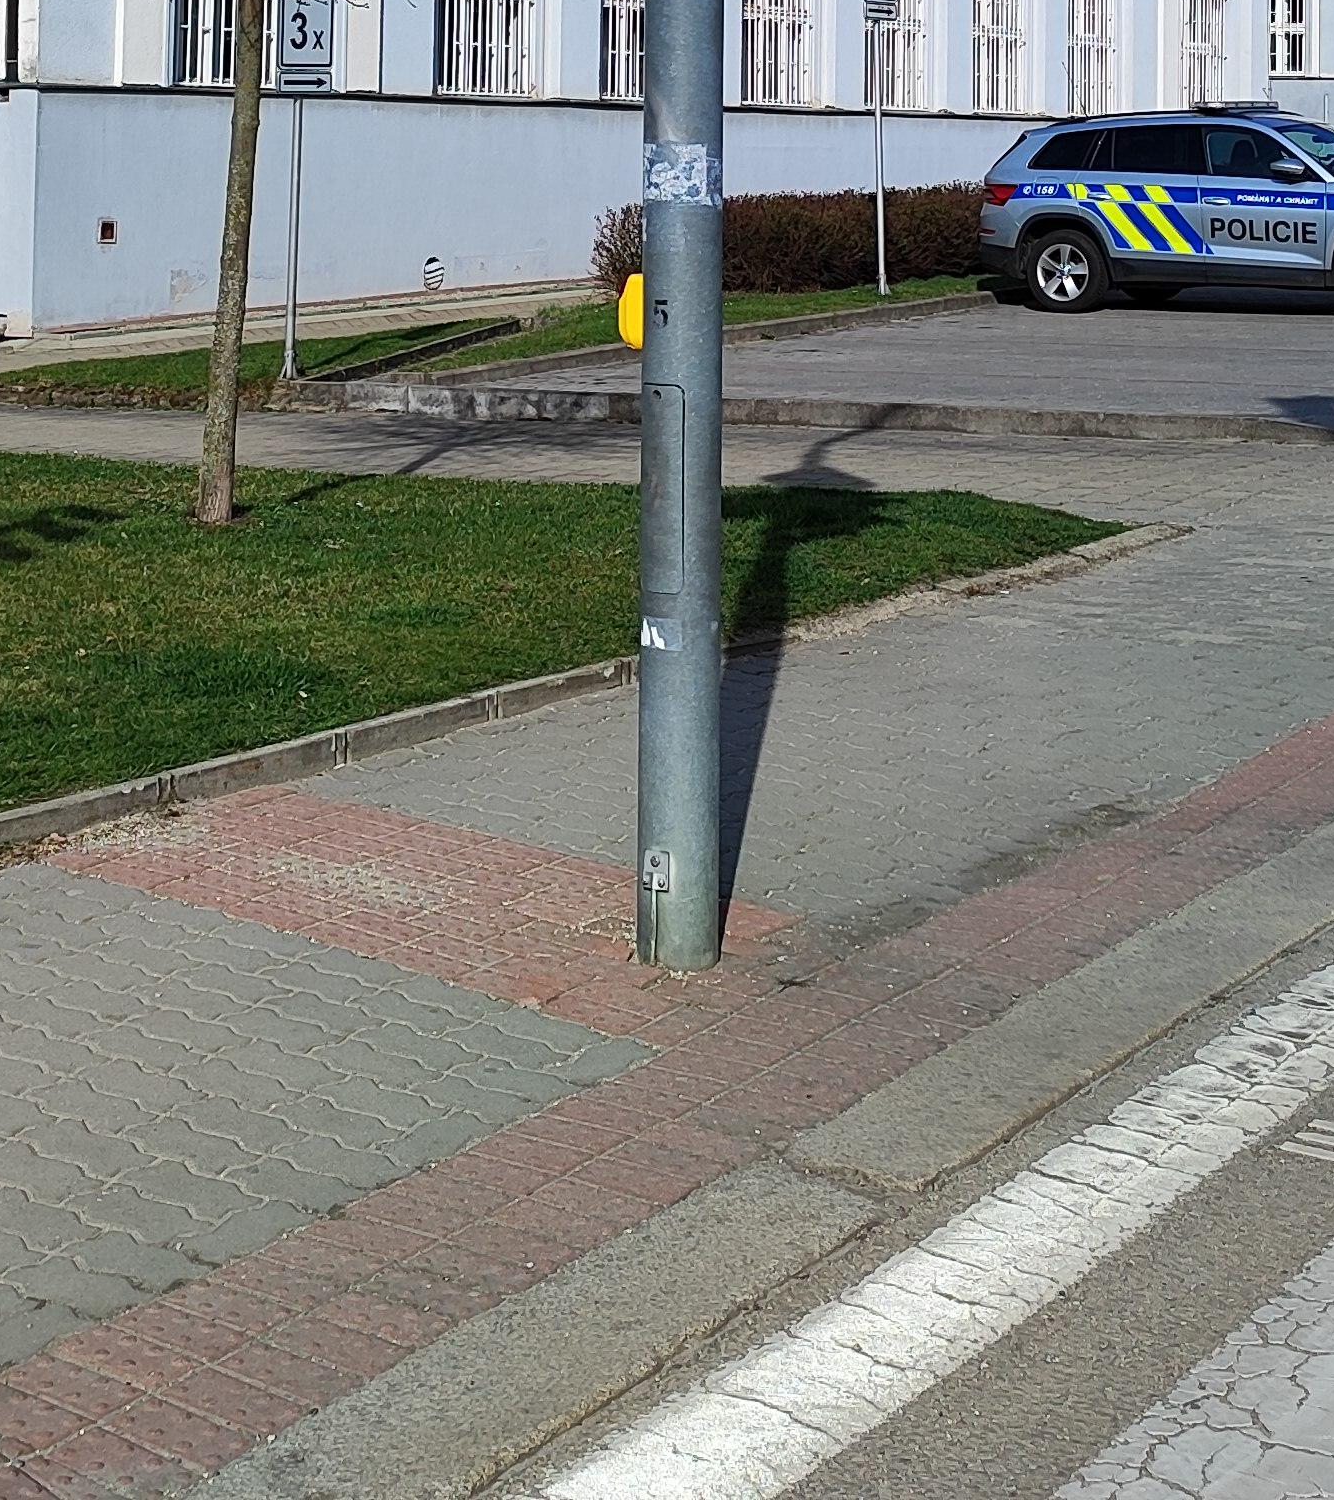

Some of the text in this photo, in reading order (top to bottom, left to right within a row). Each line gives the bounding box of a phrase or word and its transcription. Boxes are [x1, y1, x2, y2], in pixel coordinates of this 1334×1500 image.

[1037, 185, 1055, 195] 158
[1209, 217, 1318, 245] POLICIE
[653, 299, 669, 328] 5
